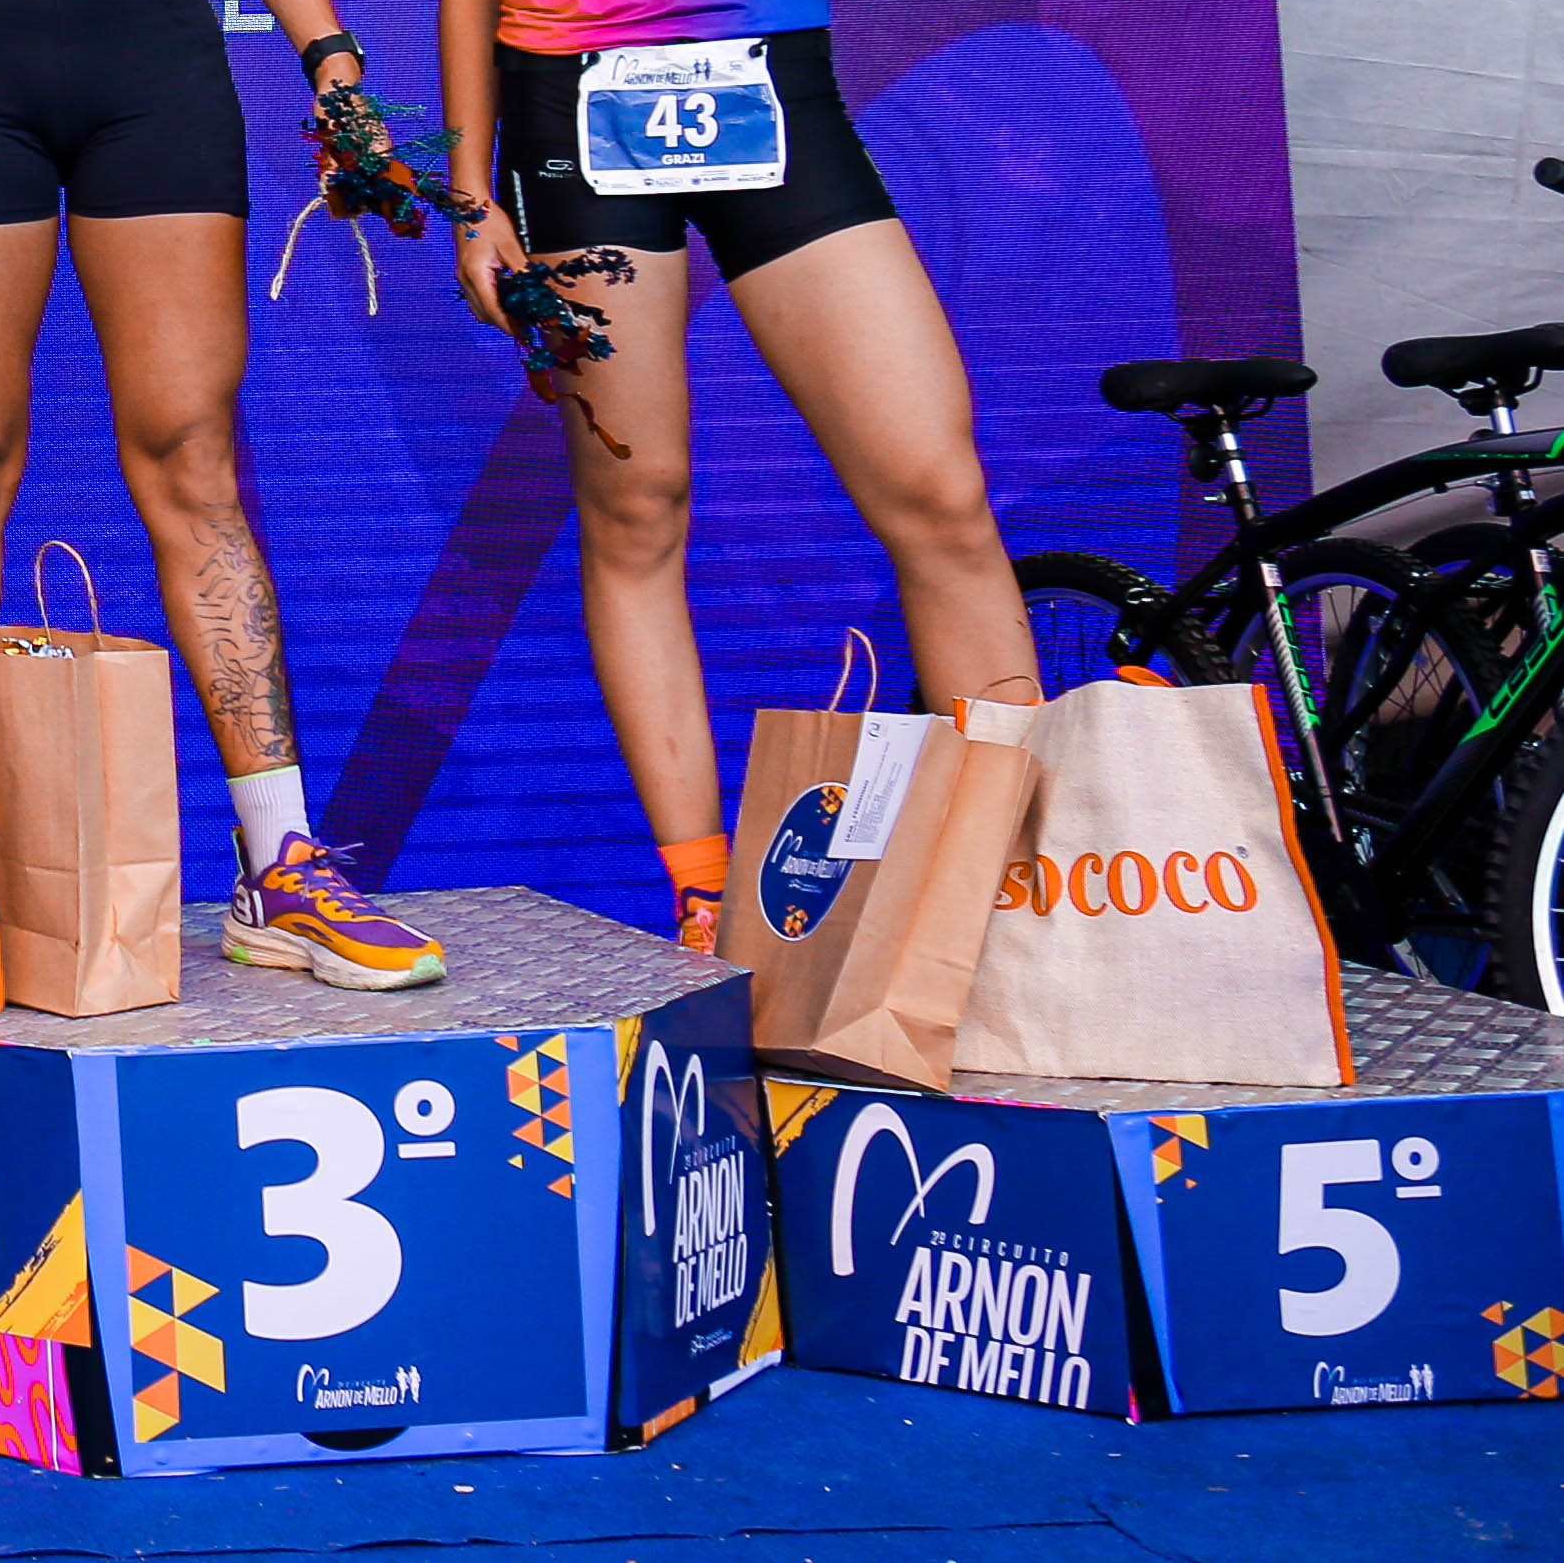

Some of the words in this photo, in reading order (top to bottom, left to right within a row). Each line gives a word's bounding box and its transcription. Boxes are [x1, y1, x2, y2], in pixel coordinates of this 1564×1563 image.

[644, 92, 719, 149] 43
[661, 152, 706, 167] GRAZI
[236, 1079, 457, 1342] 3º
[673, 1150, 745, 1263] ARNON
[952, 1233, 1069, 1267] CIRCUITO
[1278, 1135, 1442, 1338] 5º
[675, 1257, 697, 1329] DE
[696, 1233, 748, 1317] MELLO
[894, 1246, 1092, 1355] ARNON
[314, 1388, 354, 1409] ARNON
[363, 1385, 398, 1406] MELLO
